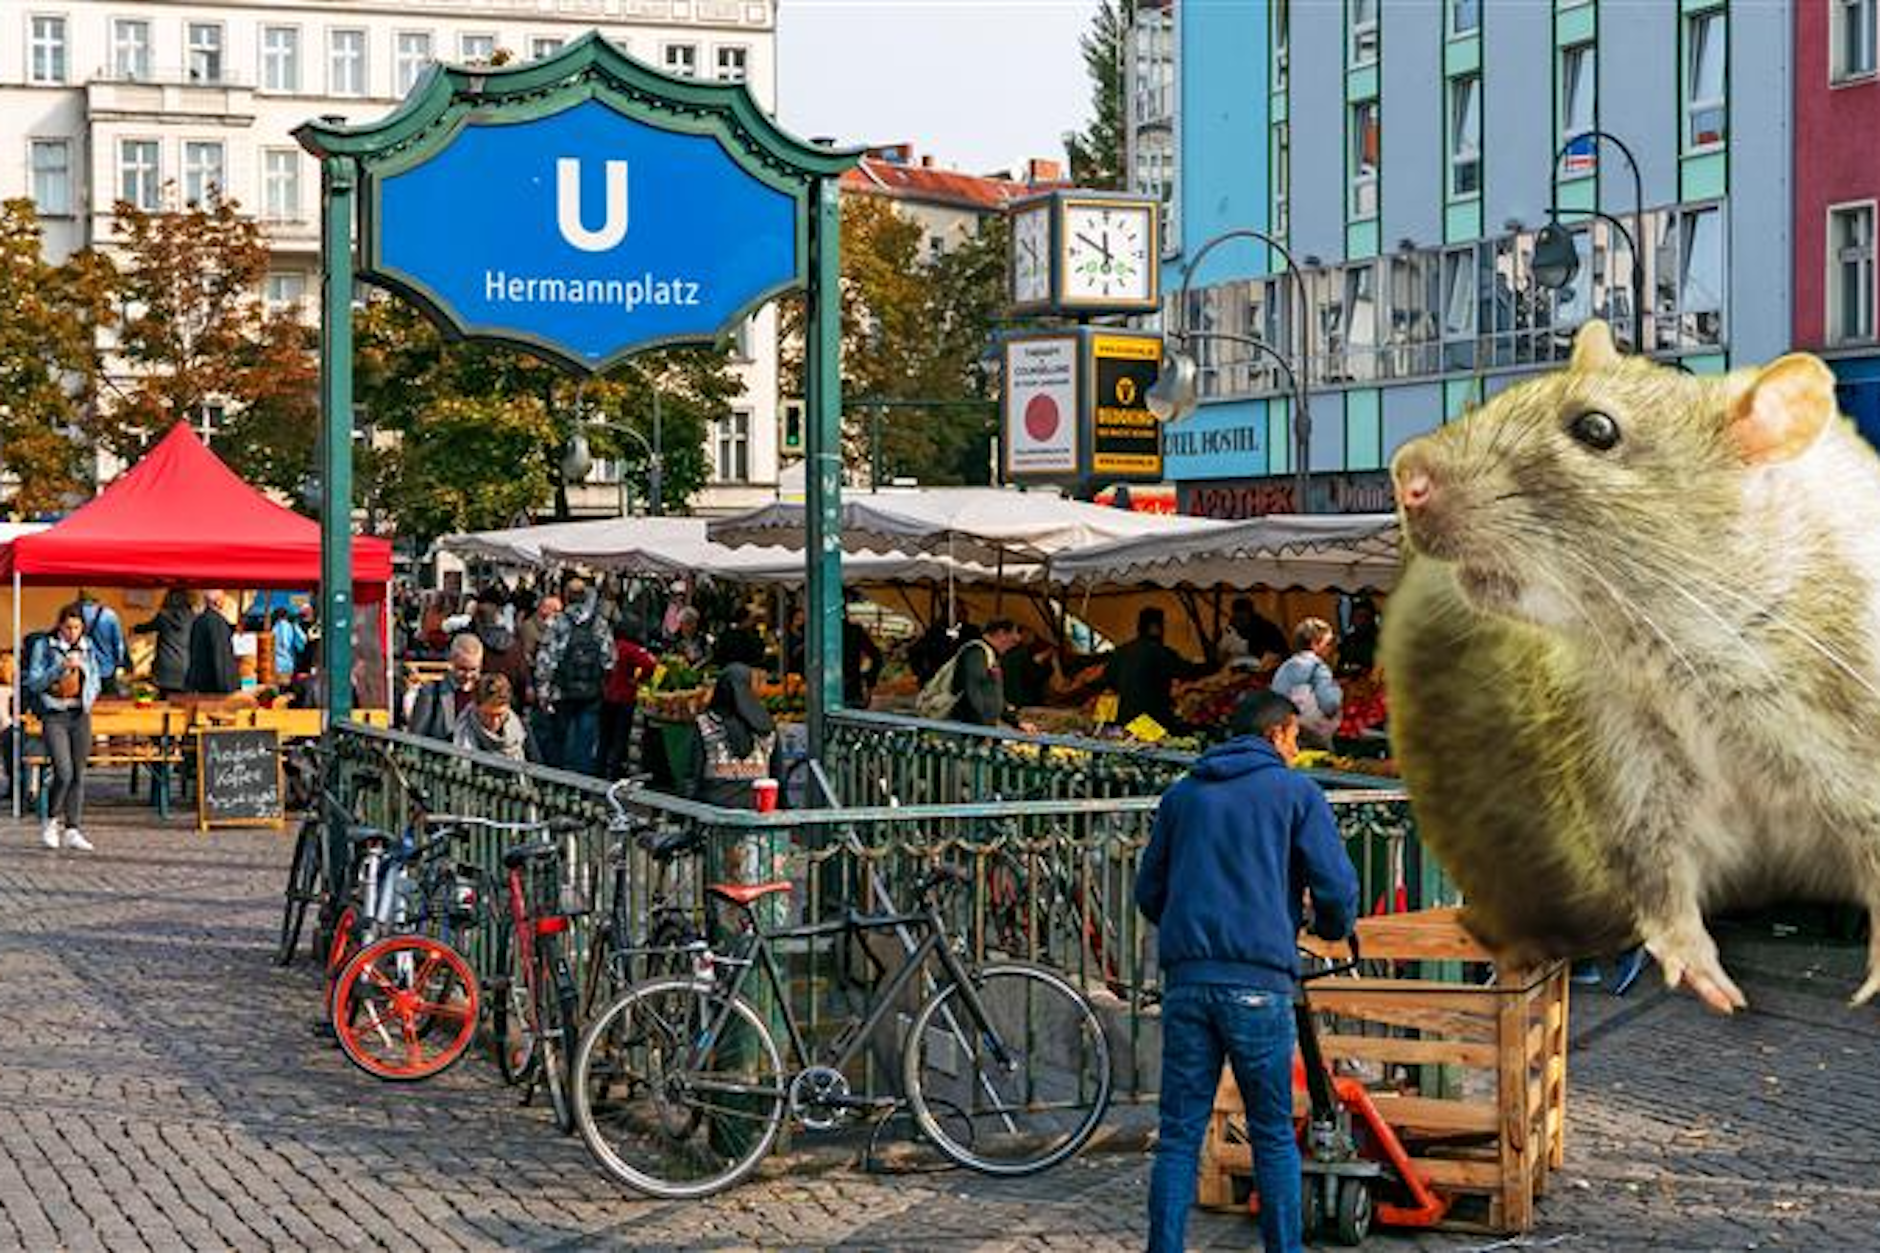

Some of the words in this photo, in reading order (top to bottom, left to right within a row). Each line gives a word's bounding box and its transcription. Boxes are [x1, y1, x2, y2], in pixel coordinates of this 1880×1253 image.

[556, 157, 629, 252] U
[485, 271, 699, 311] Hermannplatz
[1202, 426, 1259, 454] HOSTEL
